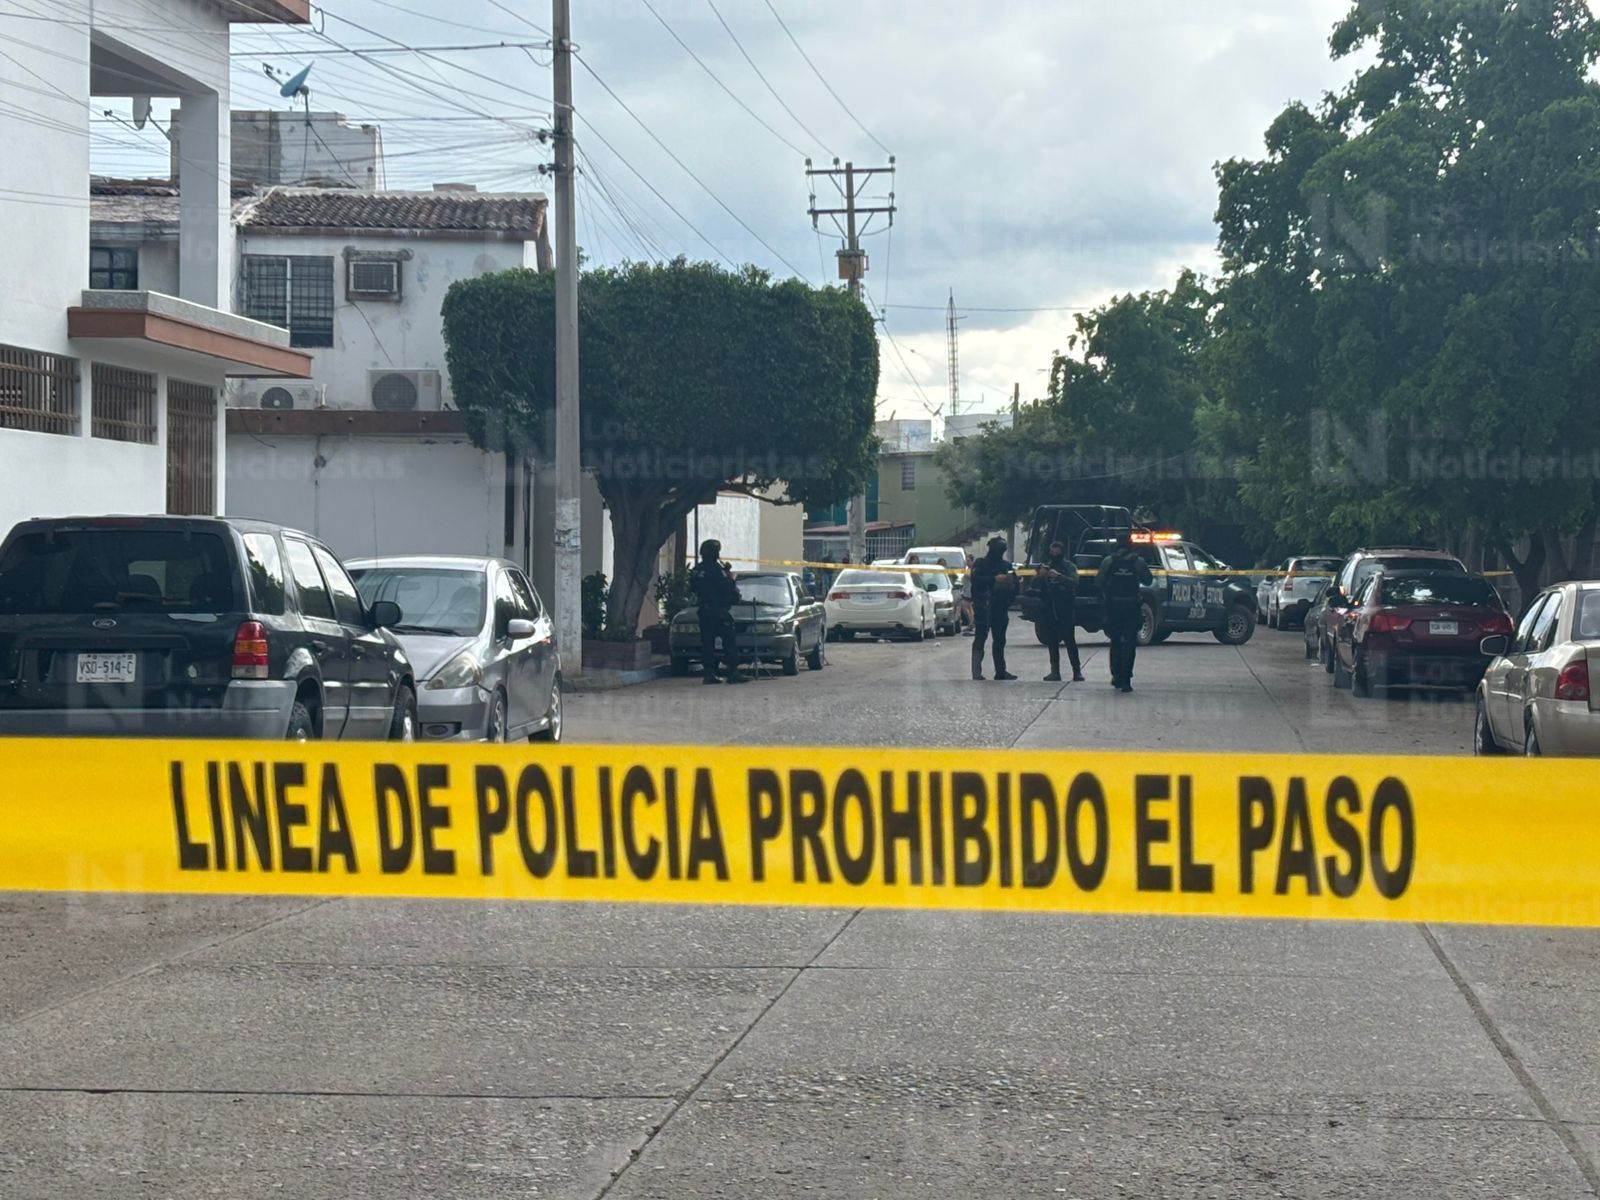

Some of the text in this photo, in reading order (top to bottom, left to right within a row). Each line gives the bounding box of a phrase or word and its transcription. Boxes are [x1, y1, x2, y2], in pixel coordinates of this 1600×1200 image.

[170, 760, 1415, 900] LINEA DE POLICIA PROHIBIDO EL PASO
